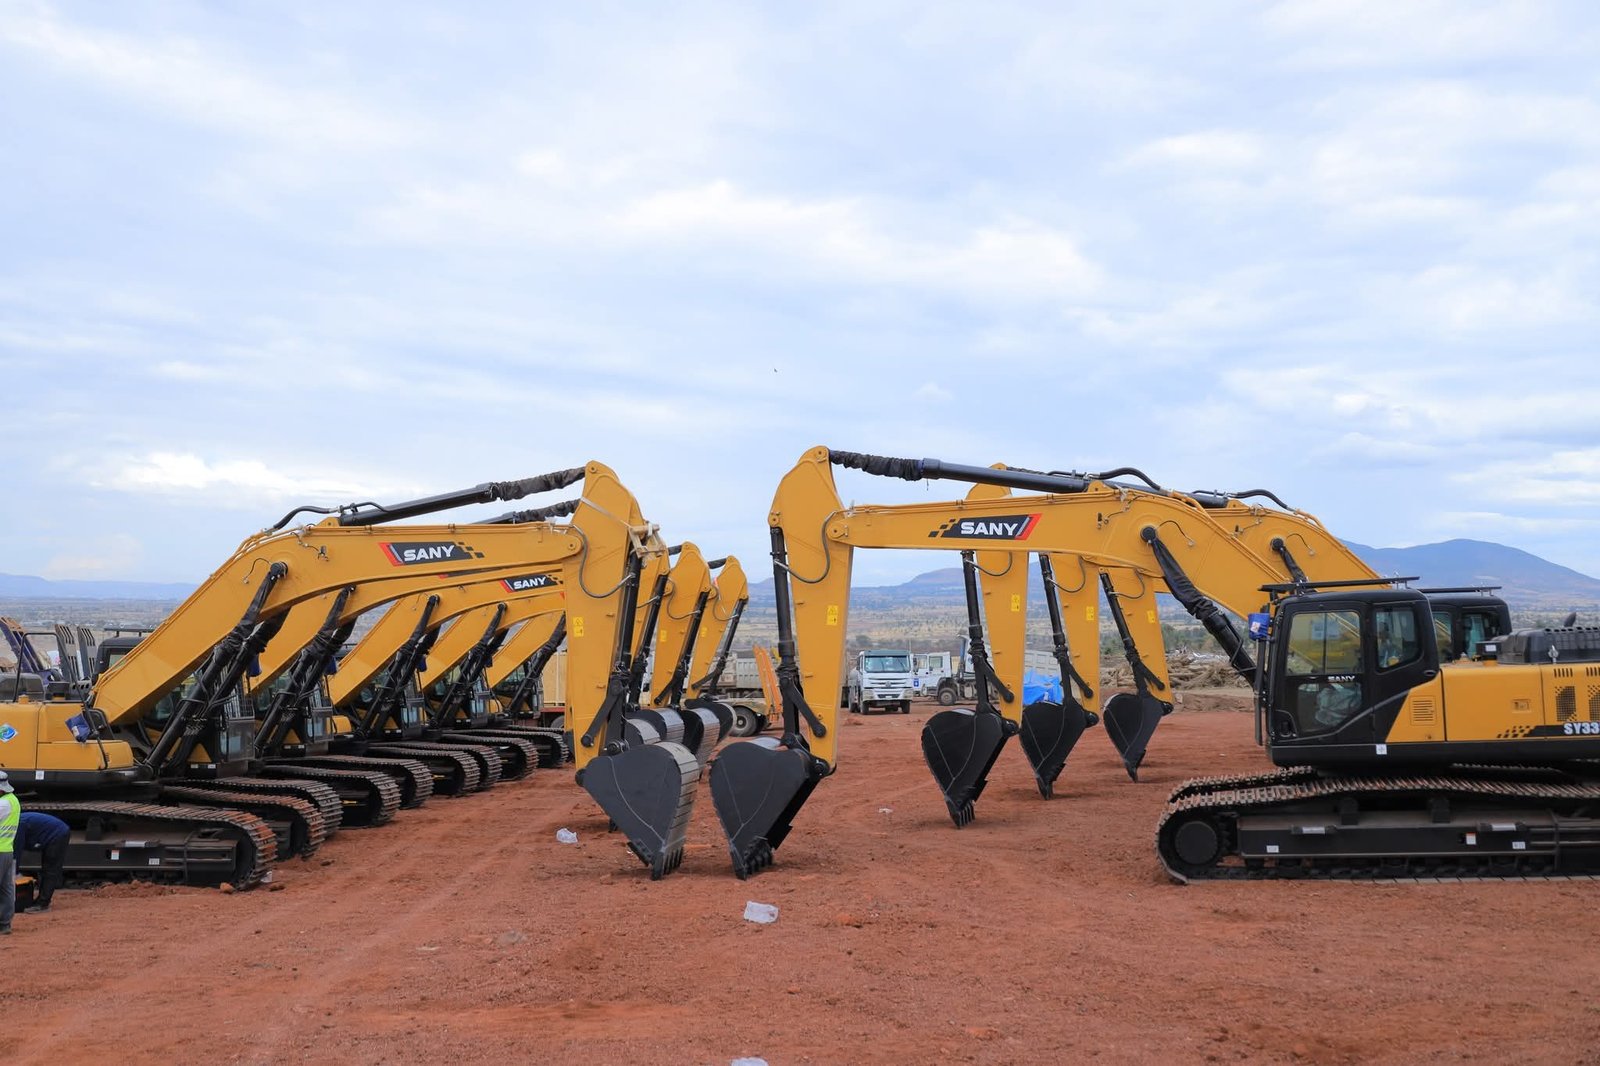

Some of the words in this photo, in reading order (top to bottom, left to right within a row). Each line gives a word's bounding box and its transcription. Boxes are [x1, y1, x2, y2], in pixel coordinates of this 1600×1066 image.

[960, 521, 1018, 536] SANY
[403, 544, 454, 562] SANY
[513, 576, 546, 590] SANY
